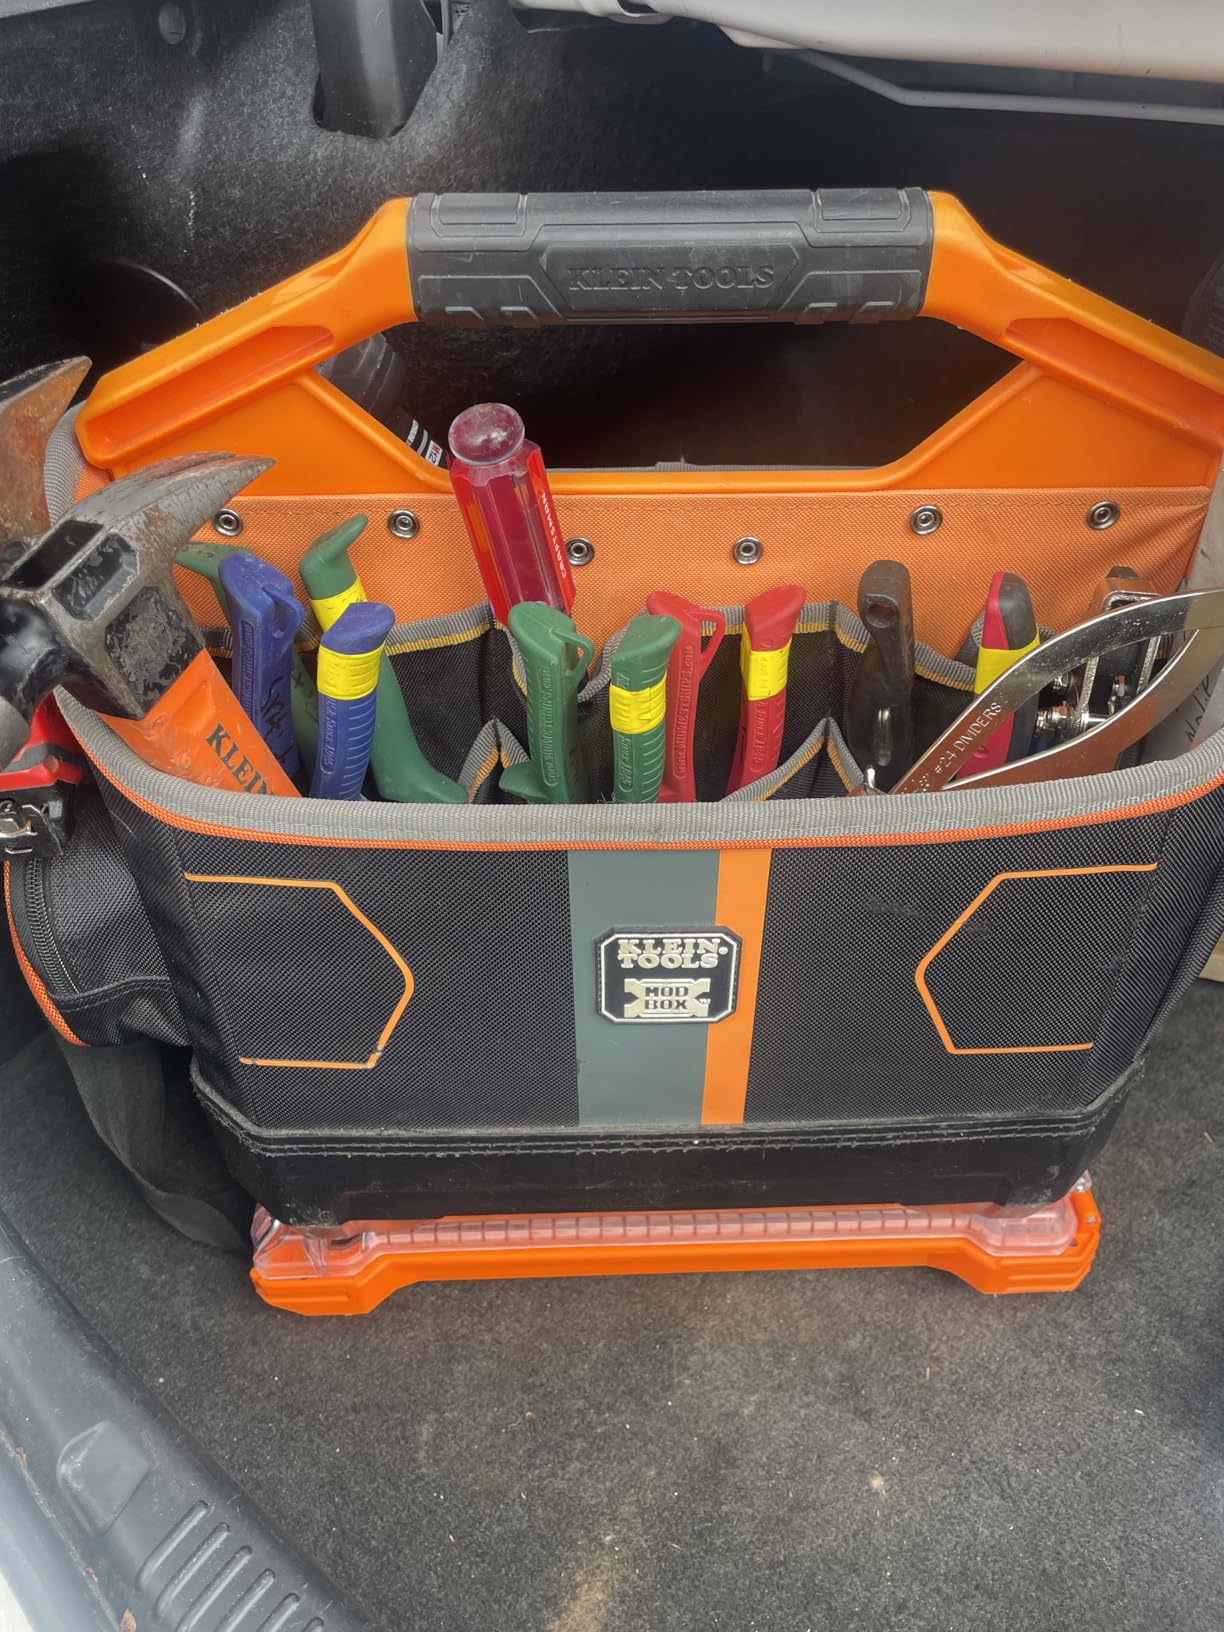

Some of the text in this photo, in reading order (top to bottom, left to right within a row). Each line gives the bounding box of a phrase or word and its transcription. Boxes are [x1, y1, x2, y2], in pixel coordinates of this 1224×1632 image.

[568, 265, 775, 291] KLEIN TOOLS
[953, 702, 1002, 752] DIVIDERS
[617, 938, 721, 955] KLEIN
[617, 953, 719, 969] TOOLS
[644, 986, 689, 997] MOD
[644, 999, 688, 1010] BOX
